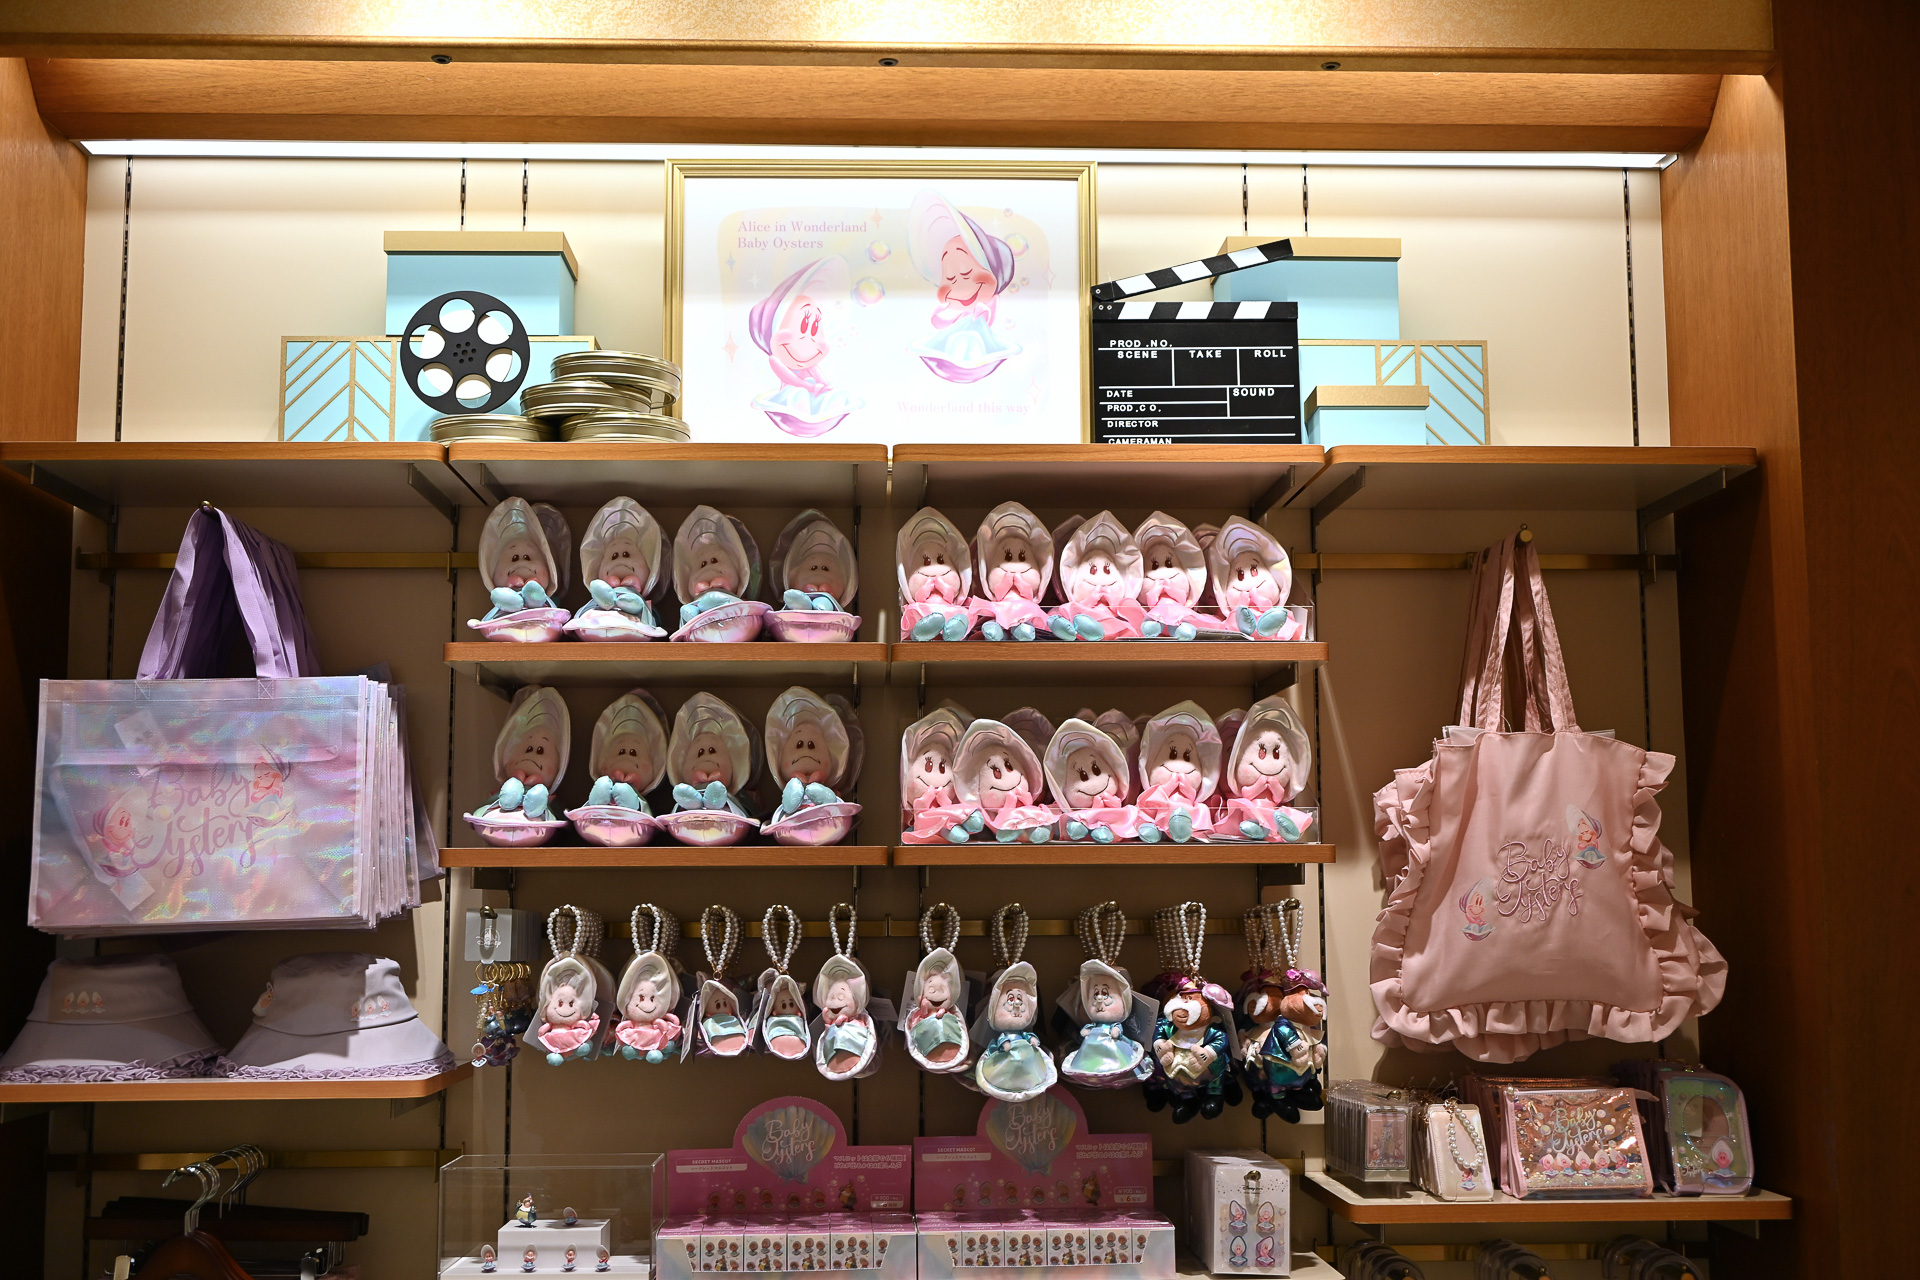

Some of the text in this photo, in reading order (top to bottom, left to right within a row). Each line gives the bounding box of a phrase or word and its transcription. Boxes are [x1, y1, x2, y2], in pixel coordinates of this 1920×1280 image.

[738, 221, 867, 233] Alice in Wonderland
[738, 237, 824, 251] Baby Oysters
[1117, 350, 1158, 359] SCENE
[1189, 350, 1222, 358] TAKE
[1254, 349, 1287, 358] ROLL
[1106, 390, 1133, 398] DATE
[1232, 388, 1275, 397] SOUND
[897, 401, 1030, 416] Wonderland this way
[1107, 420, 1159, 428] DIRECTOR
[1108, 437, 1172, 445] CAMERAMAN
[140, 759, 252, 818] Baby
[1497, 839, 1571, 882] Baby
[1496, 868, 1583, 923] Oysters
[1006, 1103, 1052, 1130] Baby
[1550, 1106, 1597, 1133] Baby
[763, 1118, 813, 1142] Baby
[1005, 1122, 1058, 1155] Oysters
[1551, 1126, 1606, 1156] Oysters
[761, 1135, 816, 1165] Oysters
